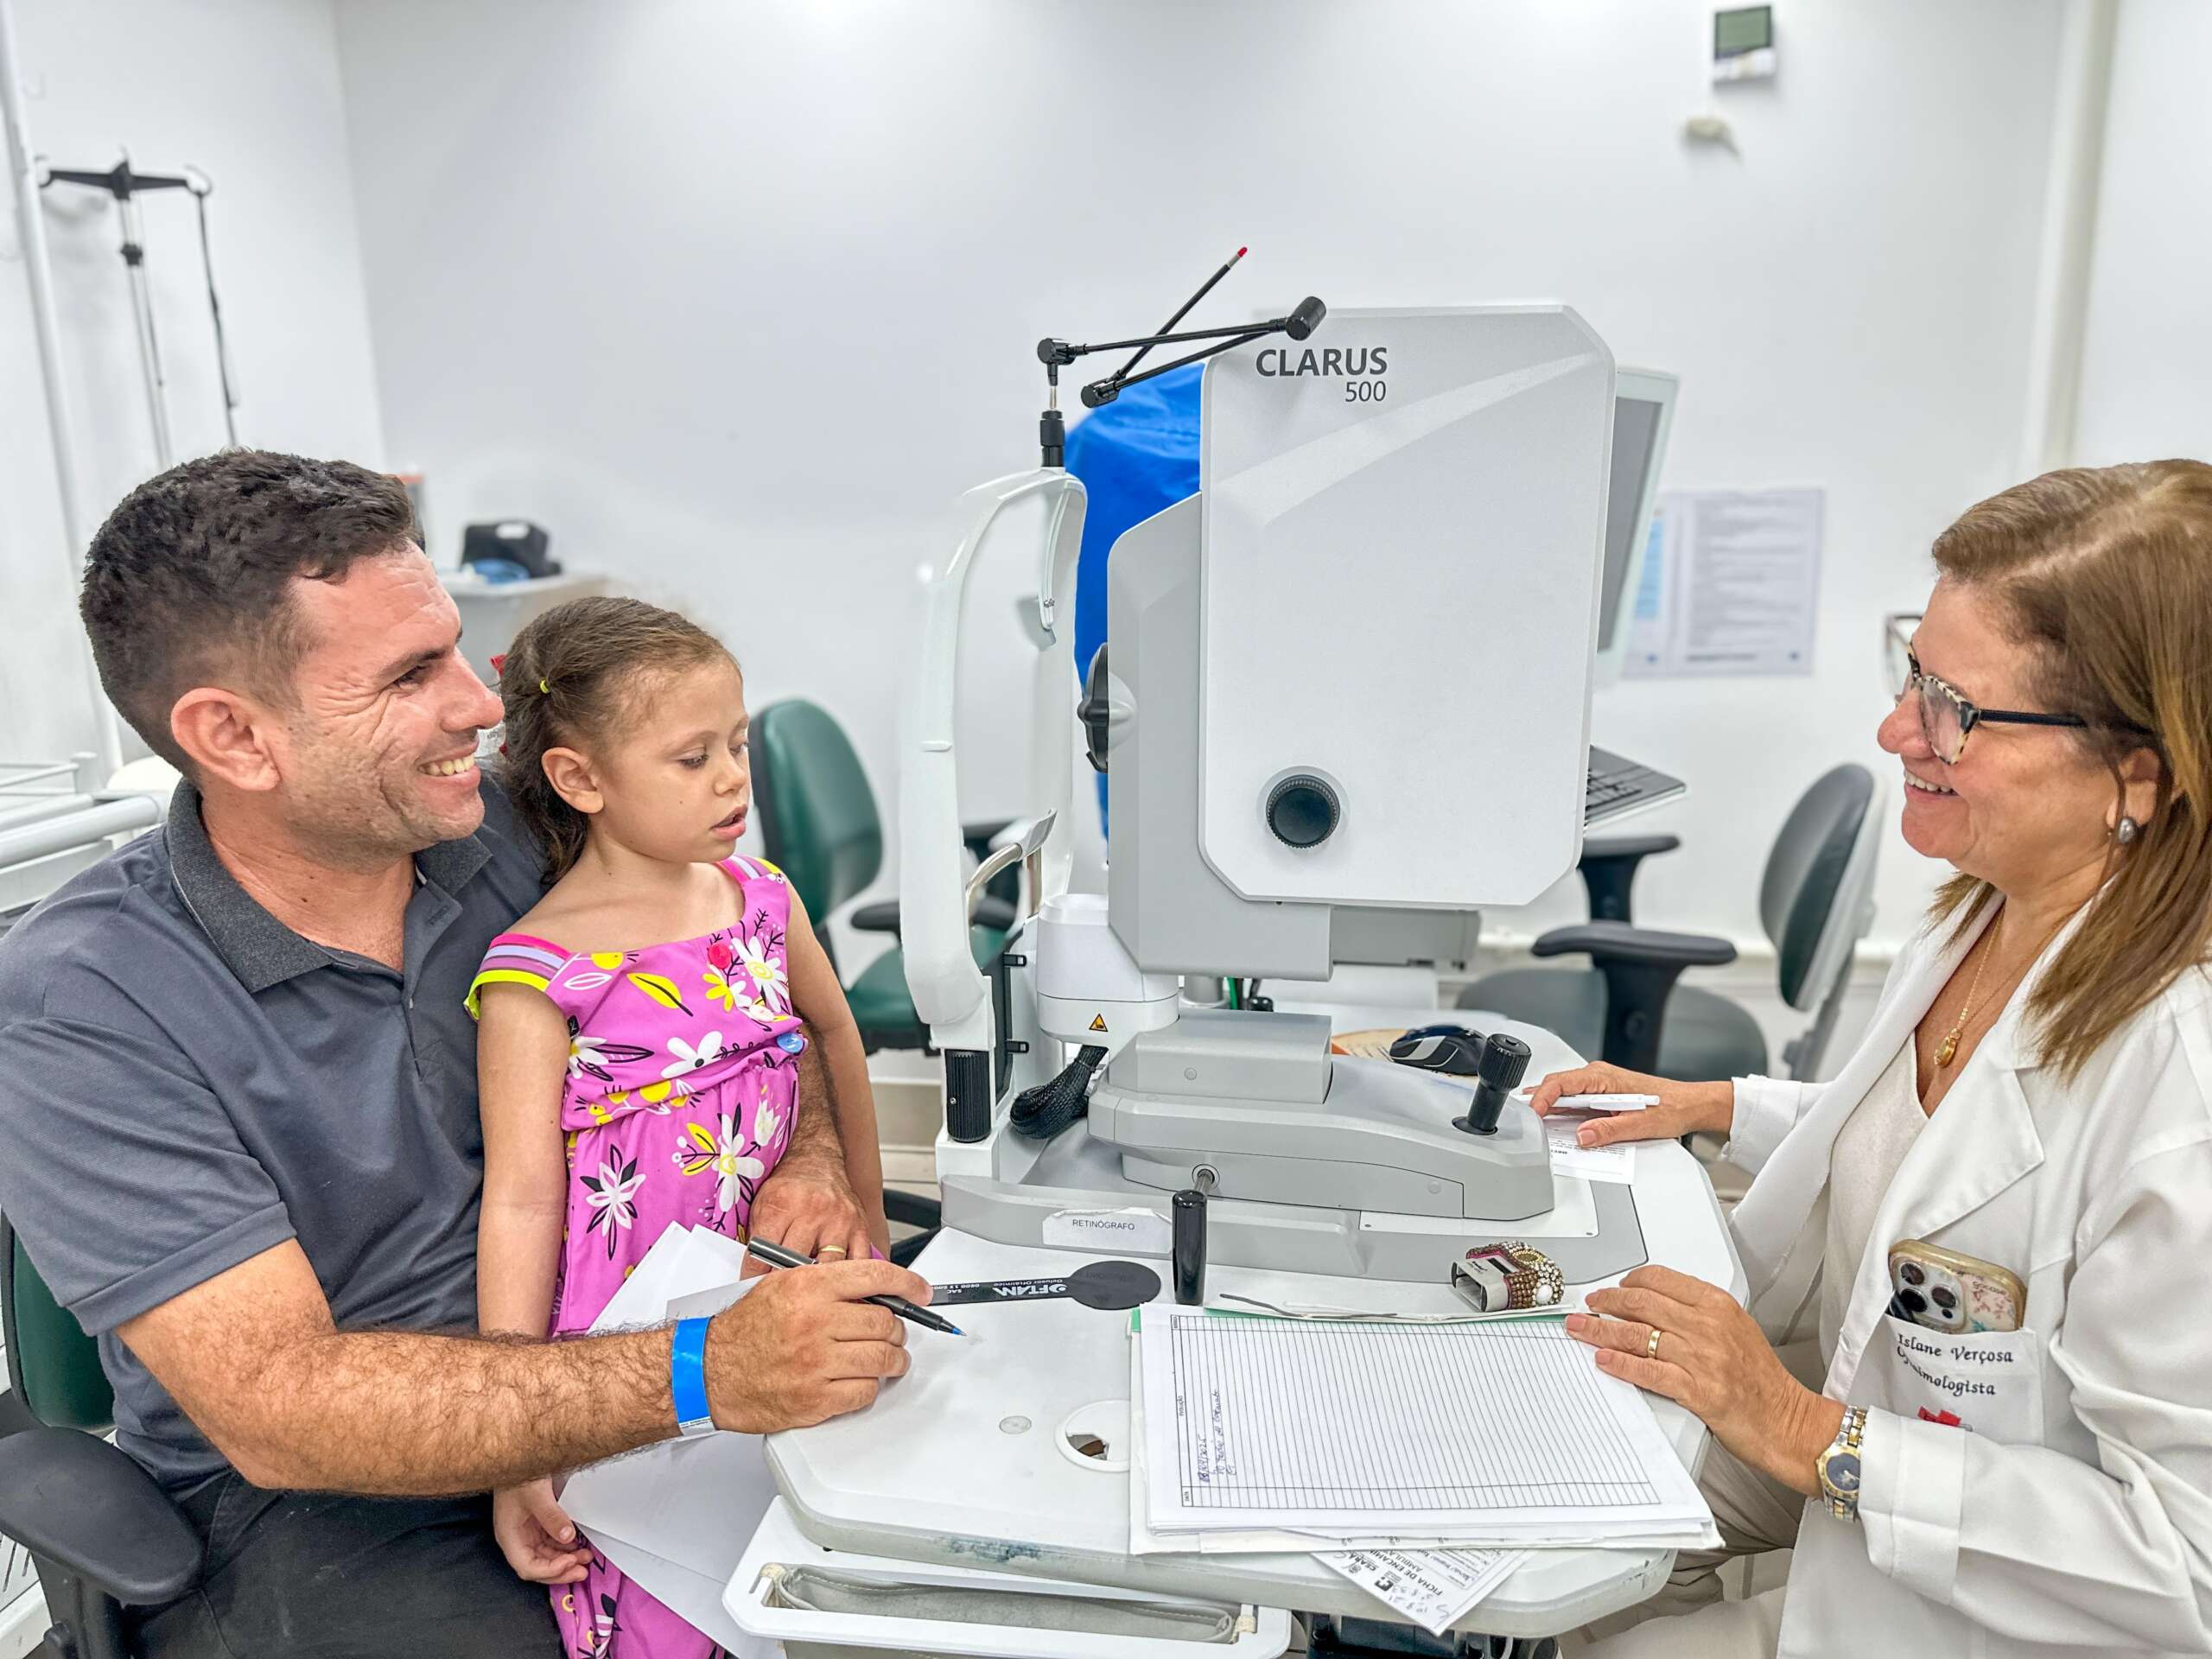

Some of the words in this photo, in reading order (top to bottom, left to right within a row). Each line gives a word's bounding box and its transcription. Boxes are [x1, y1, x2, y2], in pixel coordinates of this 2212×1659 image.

[1255, 346, 1389, 378] CLARUS
[1344, 380, 1387, 403] 500
[1950, 1345, 2014, 1364] Verçosa
[1417, 1577, 1443, 1596] FICHA
